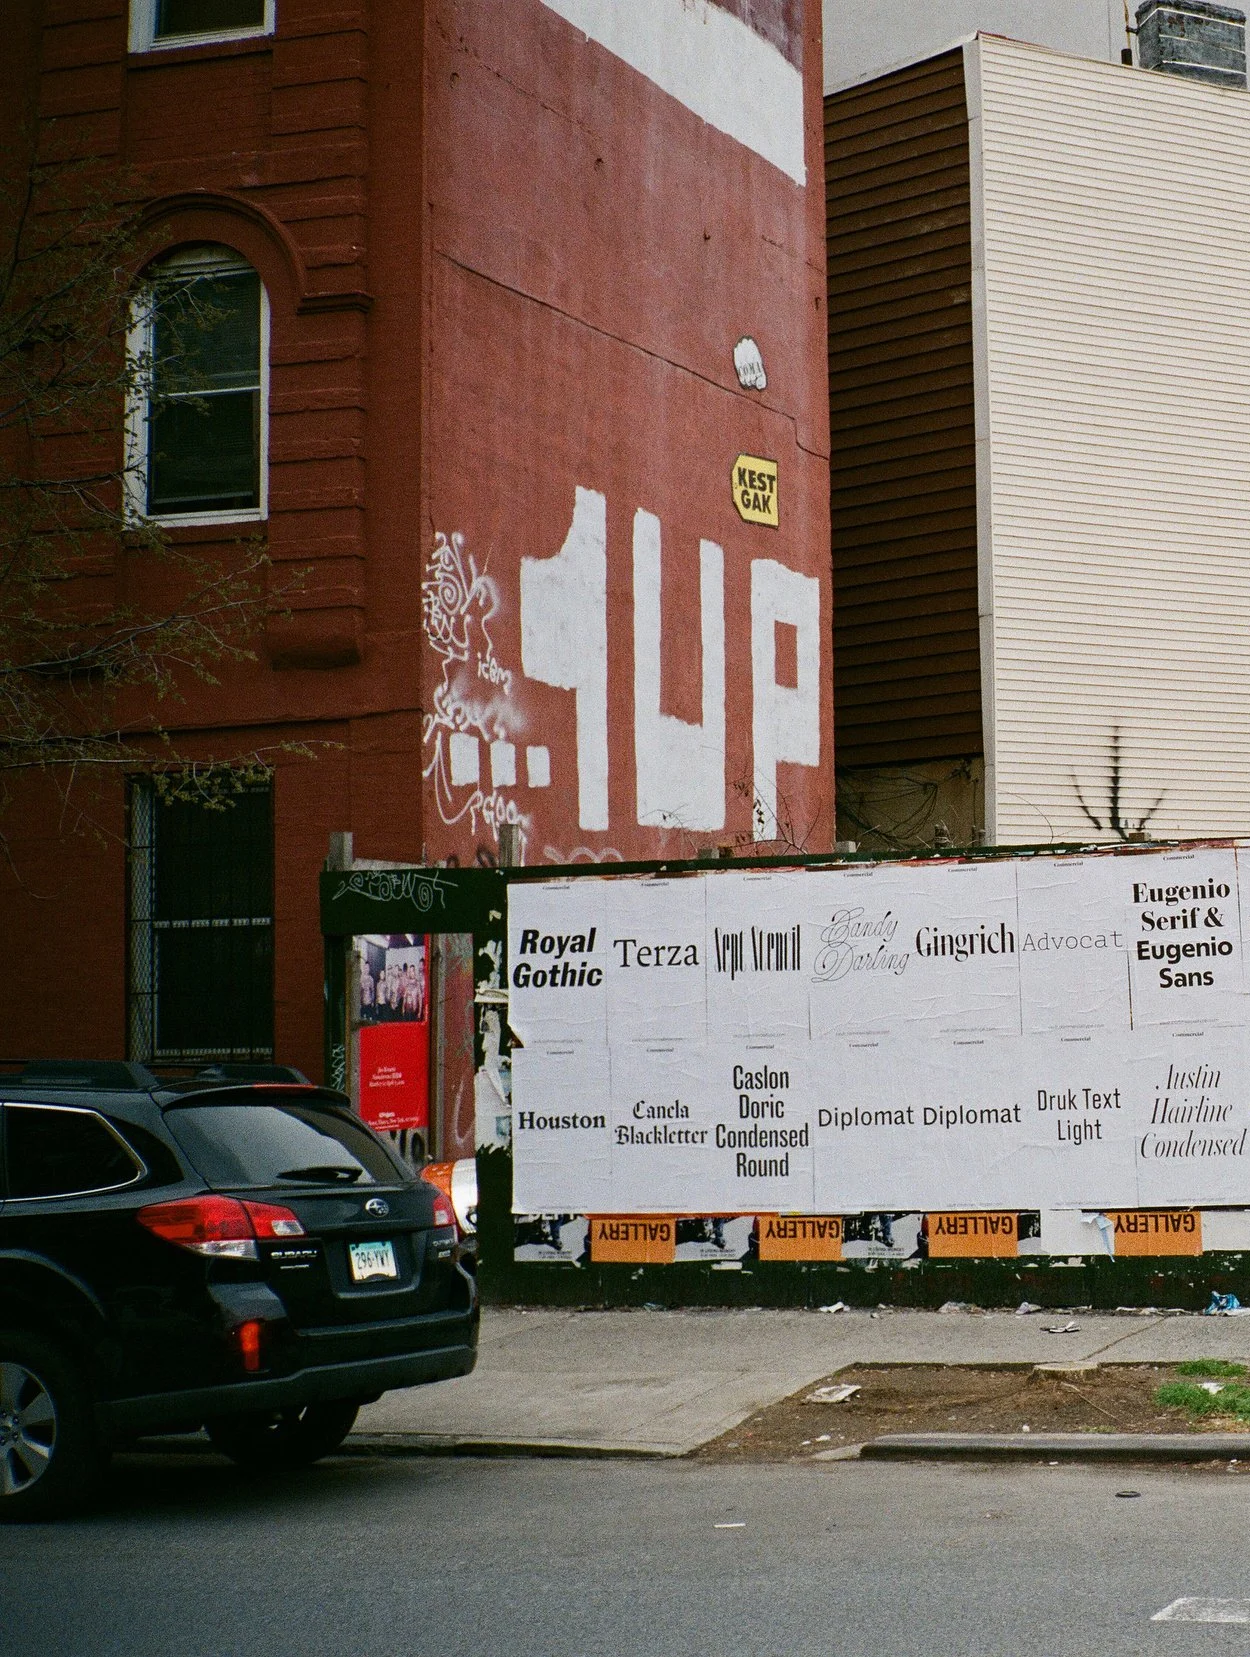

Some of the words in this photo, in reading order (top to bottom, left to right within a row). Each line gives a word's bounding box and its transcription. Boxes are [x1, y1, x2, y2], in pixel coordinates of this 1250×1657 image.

[738, 466, 776, 494] KEST
[741, 489, 771, 515] GAK
[1132, 877, 1231, 907] Eugenio
[820, 906, 899, 949] Candy
[1141, 907, 1201, 932] Serif
[1203, 906, 1225, 928] &
[519, 927, 597, 959] Royal
[613, 938, 699, 968] Terza
[751, 924, 801, 972] Stencil
[916, 922, 1015, 962] Gingrich
[1022, 930, 1123, 952] Advocat
[1136, 936, 1233, 965] Eugenio
[513, 961, 603, 989] Gothic
[811, 942, 910, 984] Darling
[1159, 967, 1214, 989] Sans
[733, 1065, 789, 1090] Caslon
[1155, 1064, 1221, 1090] Austin
[632, 1099, 690, 1120] Canela
[739, 1094, 784, 1119] Doric
[1037, 1089, 1077, 1111] Druk
[1082, 1088, 1121, 1109] Text
[1151, 1095, 1233, 1124] Hairline
[518, 1111, 606, 1130] Houston
[818, 1105, 914, 1131] Diplomat
[923, 1103, 1021, 1129] Diplomat
[614, 1125, 708, 1145] Blackletter
[715, 1122, 809, 1148] Condensed
[1057, 1119, 1102, 1145] Light
[1141, 1128, 1247, 1158] Condensed
[736, 1152, 789, 1177] Round
[597, 1222, 671, 1242] GALLERY
[765, 1219, 841, 1239] GALLERY
[935, 1215, 1013, 1235] GALLERY
[1114, 1214, 1196, 1233] GALLERY
